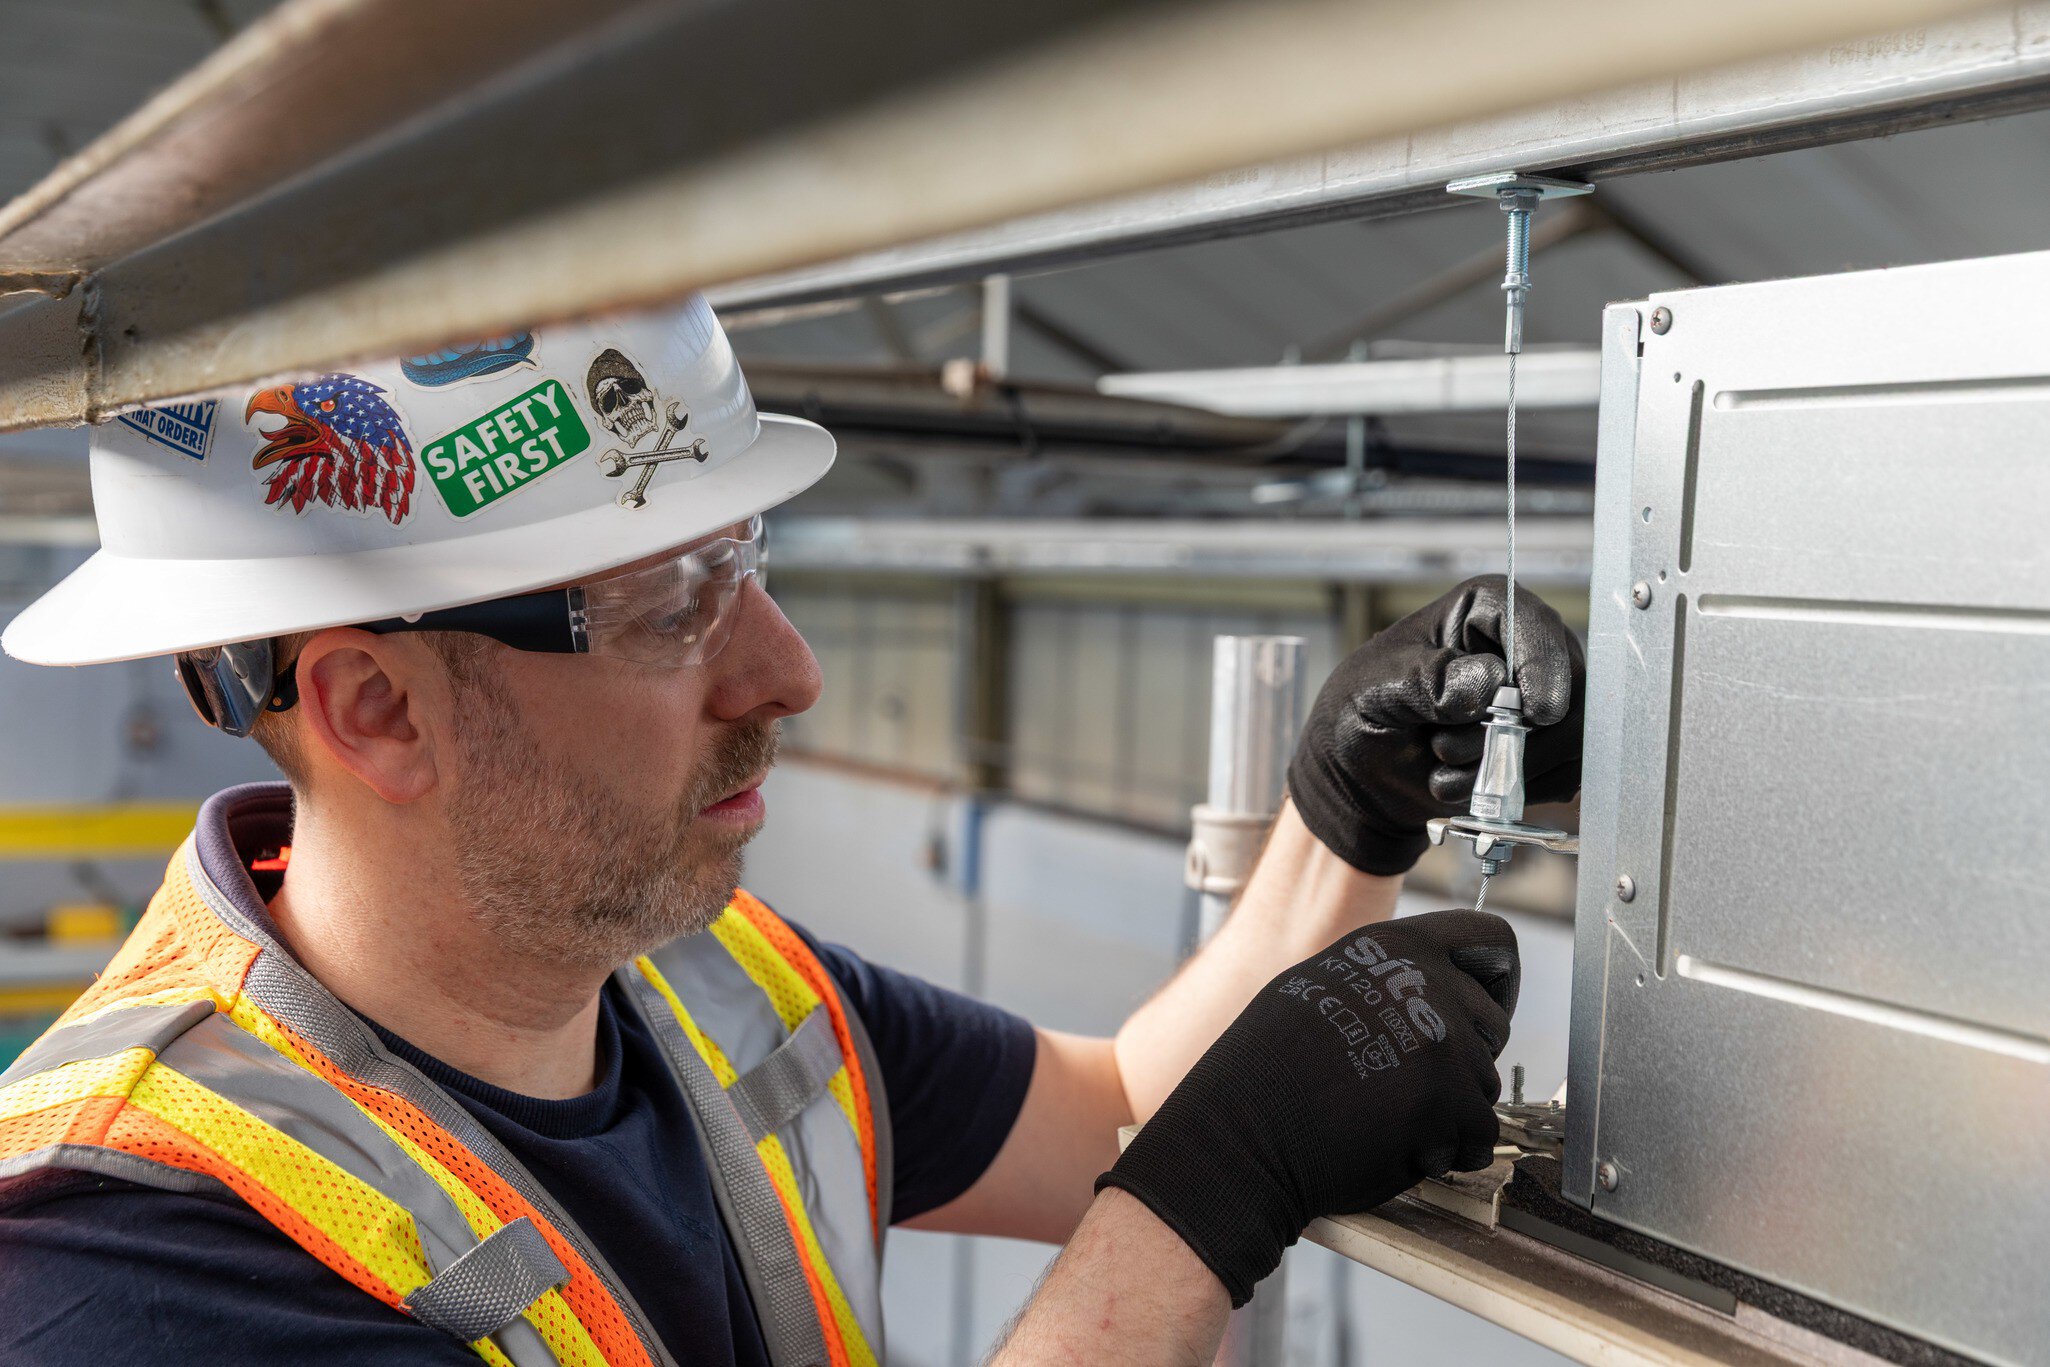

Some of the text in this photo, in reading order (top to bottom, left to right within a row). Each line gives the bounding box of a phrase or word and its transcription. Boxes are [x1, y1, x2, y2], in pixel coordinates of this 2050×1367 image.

[158, 416, 204, 451] ORDER!
[427, 384, 561, 480] SAFETY
[462, 426, 565, 504] FIRST
[1318, 956, 1382, 1005] KF120
[1344, 937, 1446, 1042] site
